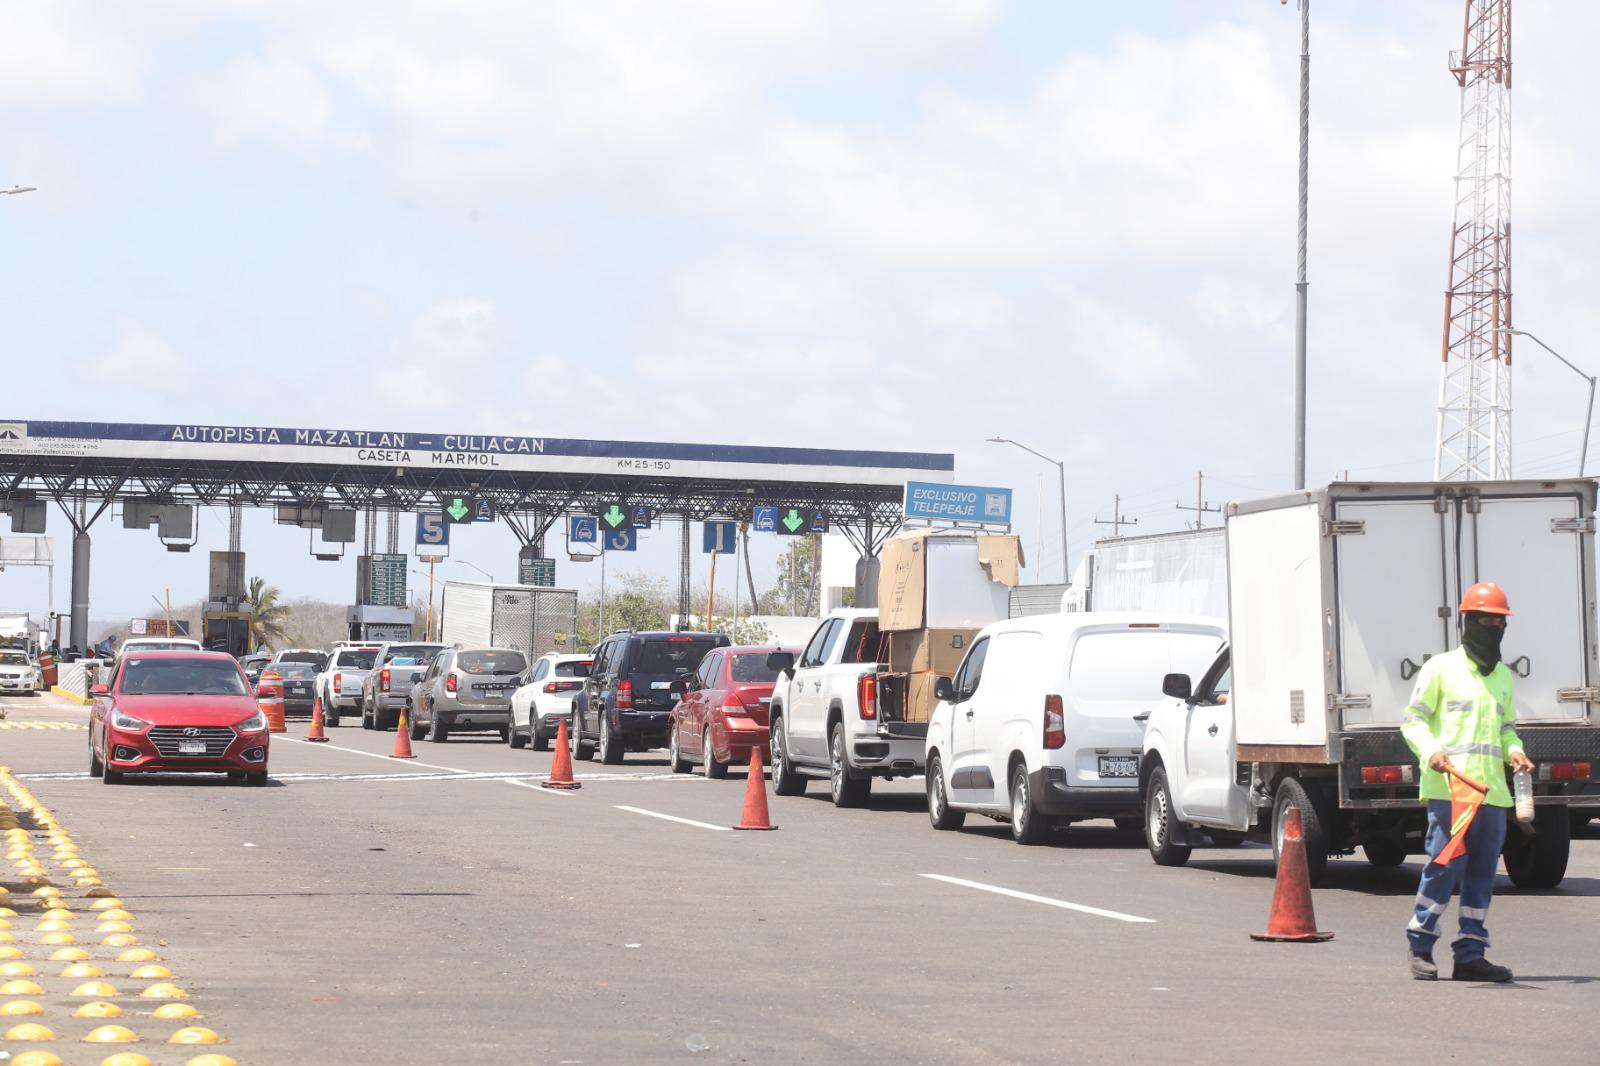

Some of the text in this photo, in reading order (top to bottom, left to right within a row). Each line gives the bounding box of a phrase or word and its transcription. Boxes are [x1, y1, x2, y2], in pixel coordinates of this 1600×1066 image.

[171, 426, 281, 443] AUTOPISTA
[295, 429, 405, 448] MAZATLAN
[443, 435, 544, 453] CULIACAN
[357, 449, 500, 466] CASETA MARMOL
[617, 459, 632, 468] KM
[913, 488, 977, 503] EXCLUSIVO
[912, 501, 976, 516] TELEPEAJE
[423, 514, 443, 543] 5
